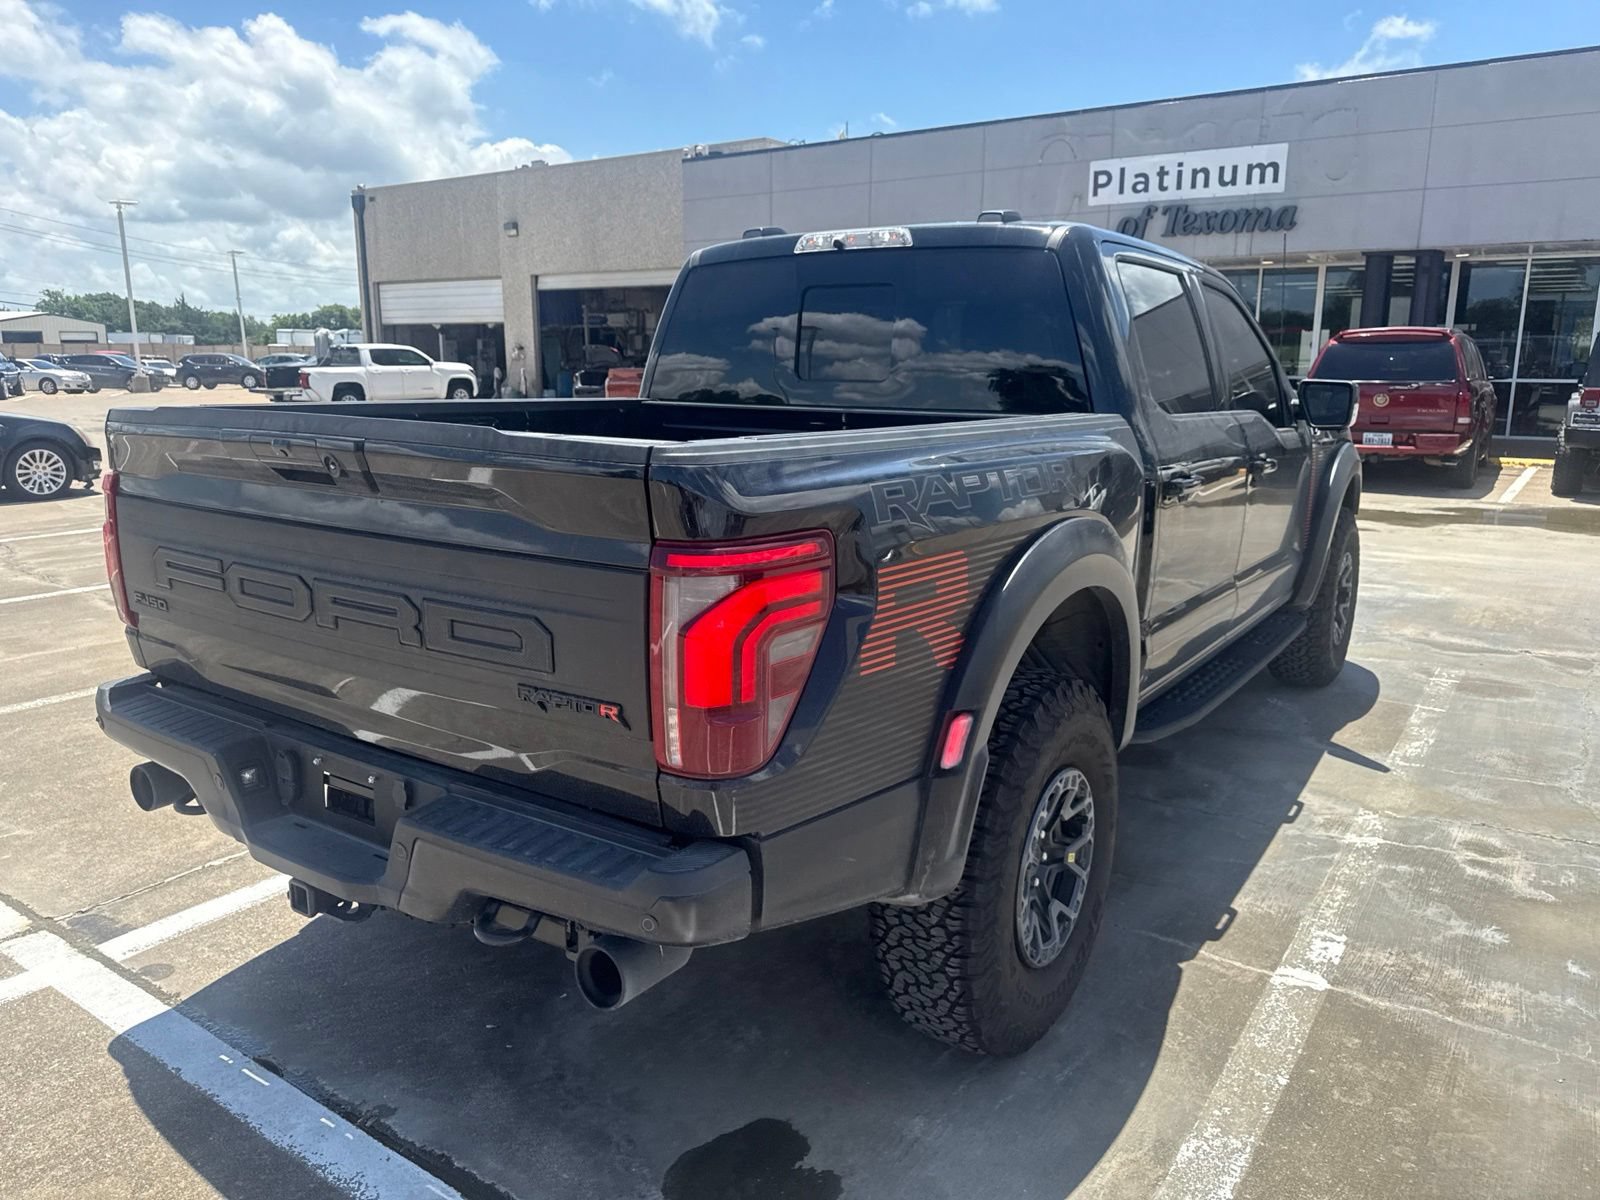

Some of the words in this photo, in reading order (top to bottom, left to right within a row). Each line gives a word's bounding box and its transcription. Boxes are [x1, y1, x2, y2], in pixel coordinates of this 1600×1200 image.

[1092, 160, 1280, 197] Platinum
[1116, 205, 1158, 238] of
[1160, 203, 1298, 238] Texoma
[869, 459, 1077, 533] RAPTOR
[152, 545, 556, 674] FORD
[517, 683, 631, 731] RAPTOR
